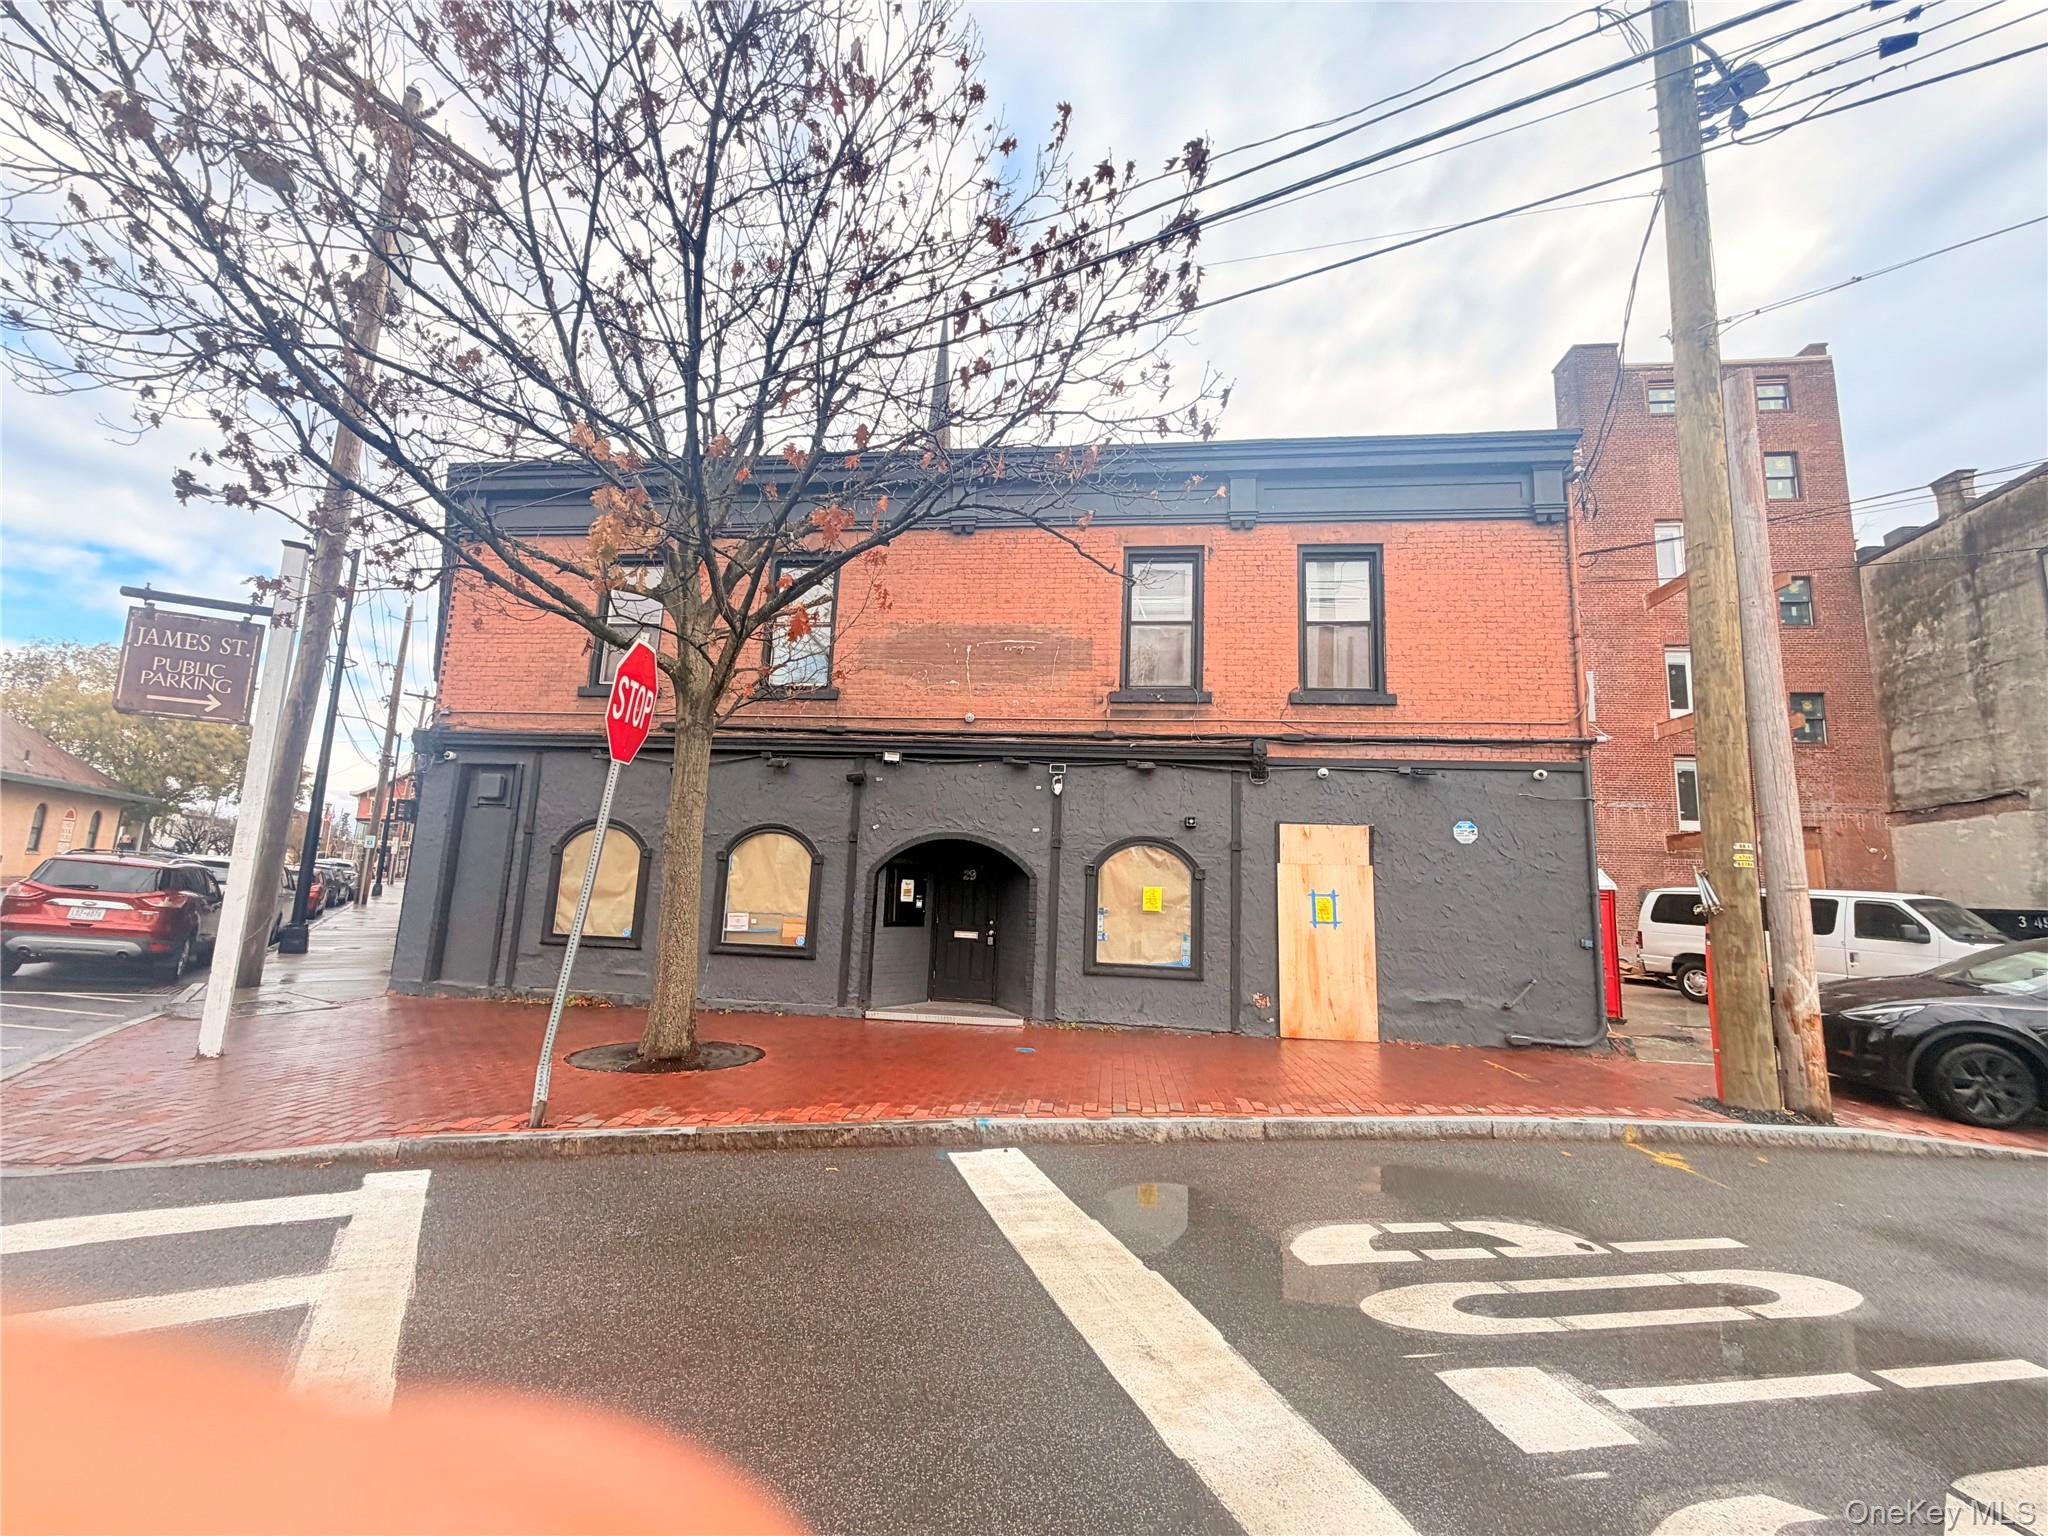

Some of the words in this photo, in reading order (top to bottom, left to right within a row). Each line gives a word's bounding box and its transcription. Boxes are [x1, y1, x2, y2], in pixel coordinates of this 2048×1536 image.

[133, 626, 212, 652] JAMES
[219, 637, 250, 657] ST.
[152, 656, 227, 679] PUBLIC
[140, 670, 233, 694] PARKING
[612, 675, 654, 729] STOP
[963, 869, 977, 880] 29
